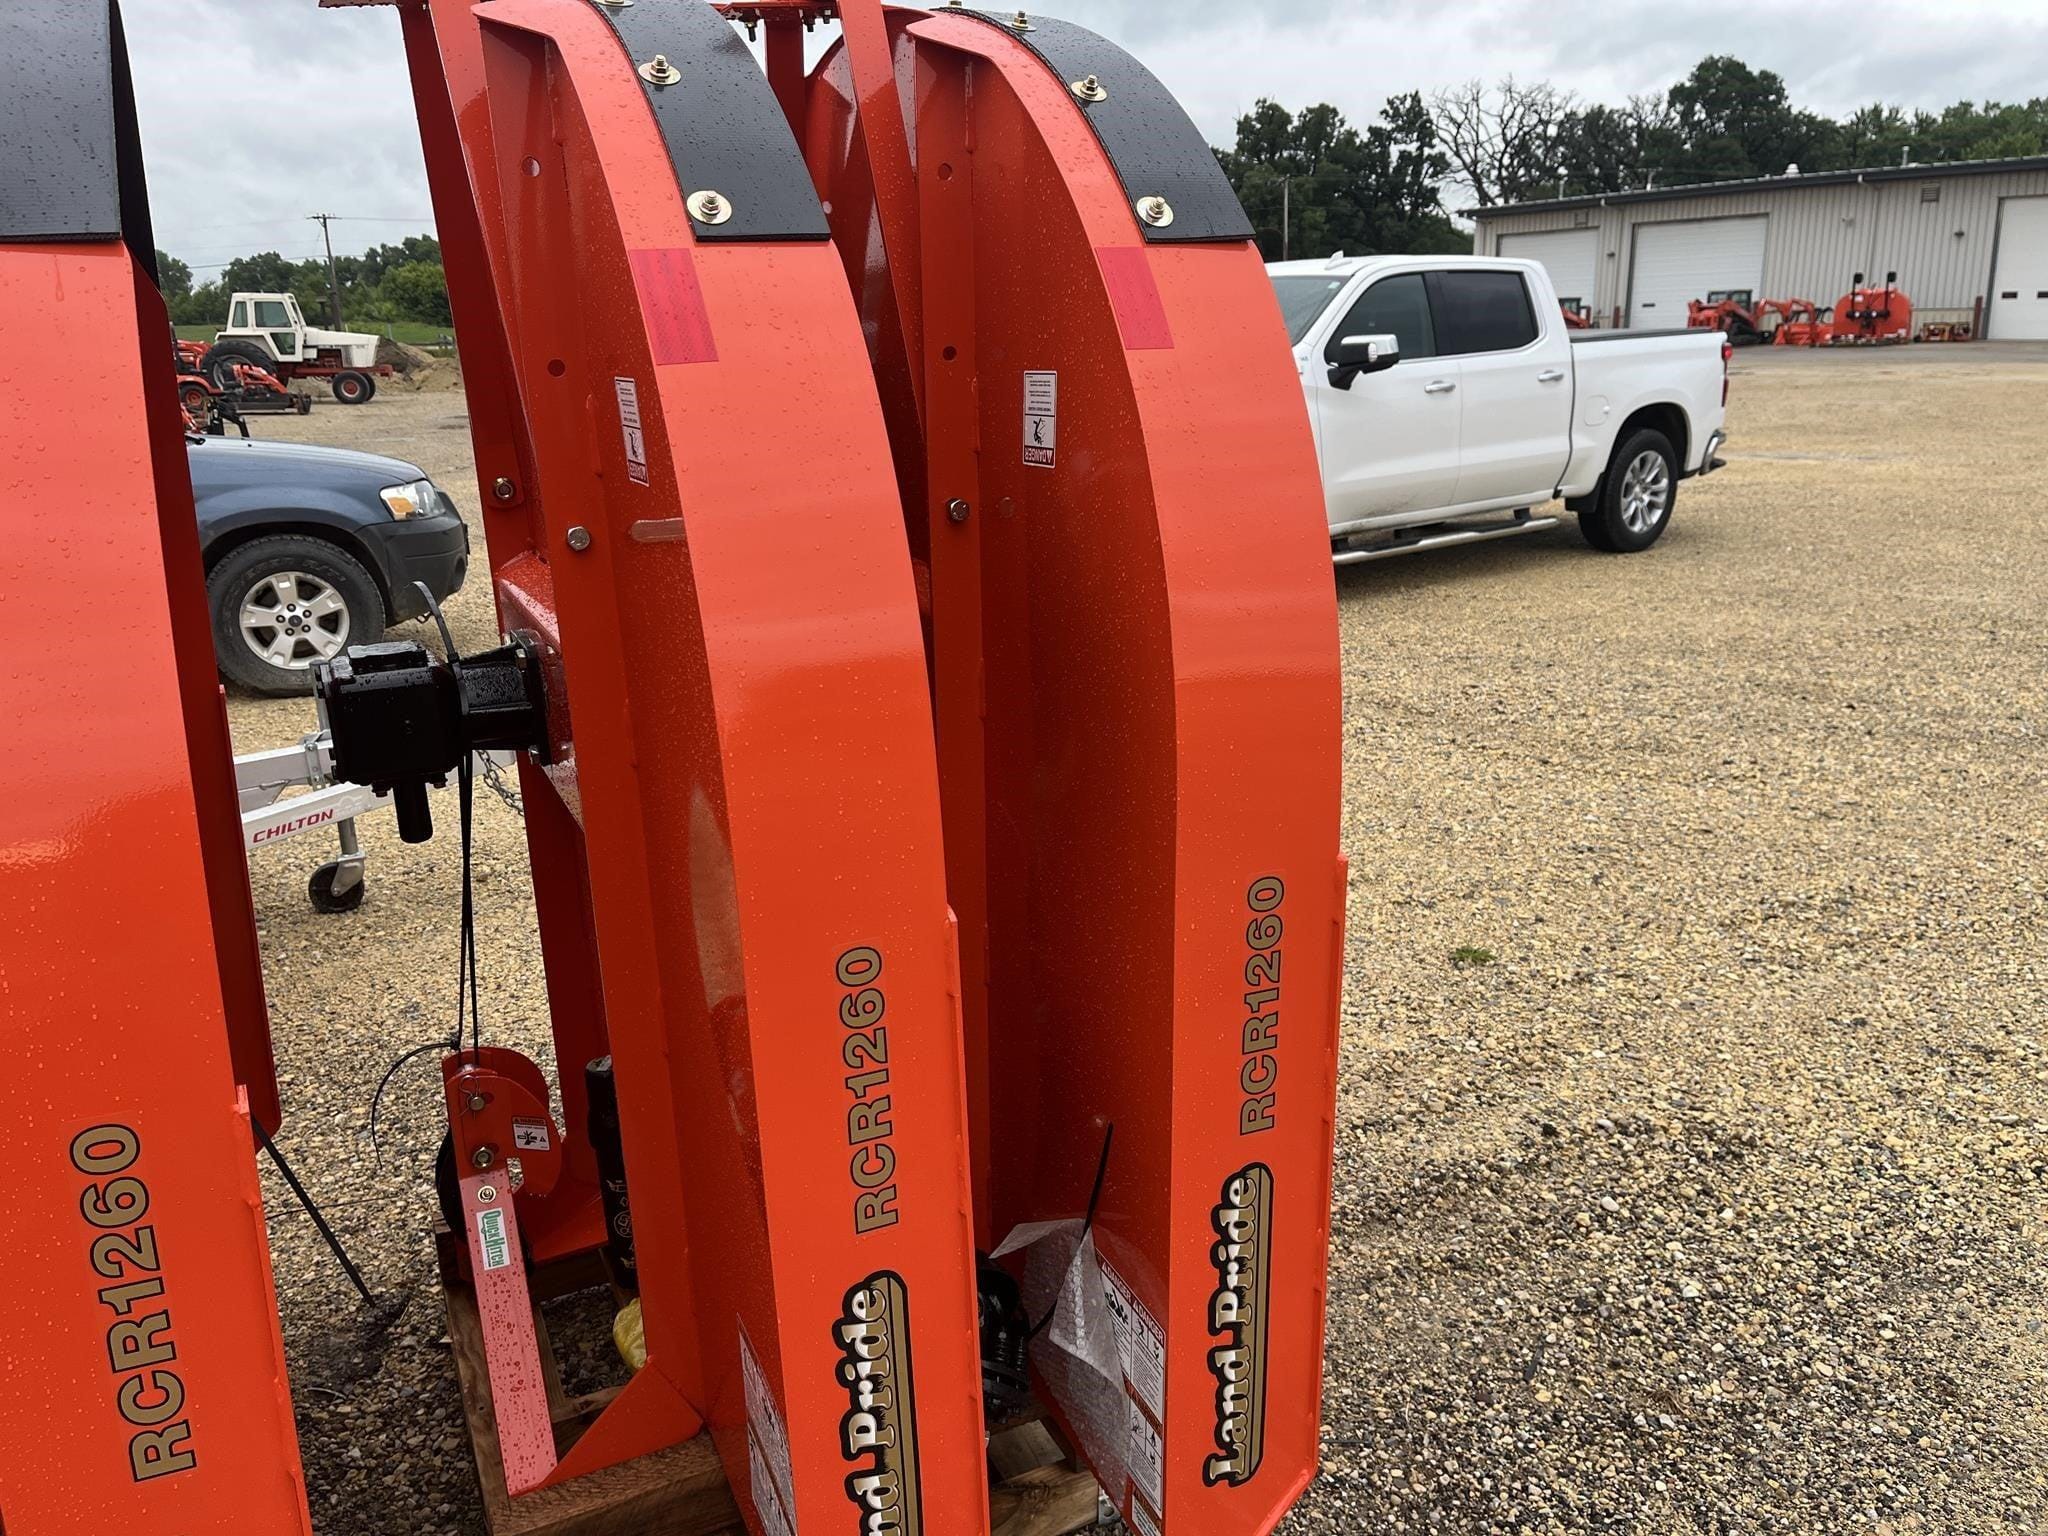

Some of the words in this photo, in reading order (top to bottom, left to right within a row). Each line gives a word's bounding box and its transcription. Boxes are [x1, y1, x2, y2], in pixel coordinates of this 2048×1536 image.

[252, 808, 335, 844] CHILTON
[1239, 875, 1286, 1136] RCR1260
[835, 945, 900, 1235] RCR1260
[69, 1122, 198, 1483] RCR1260
[1213, 1176, 1258, 1329] Pride
[840, 1286, 897, 1455] Pride
[1208, 1343, 1251, 1482] Land
[852, 1466, 902, 1536] nd
